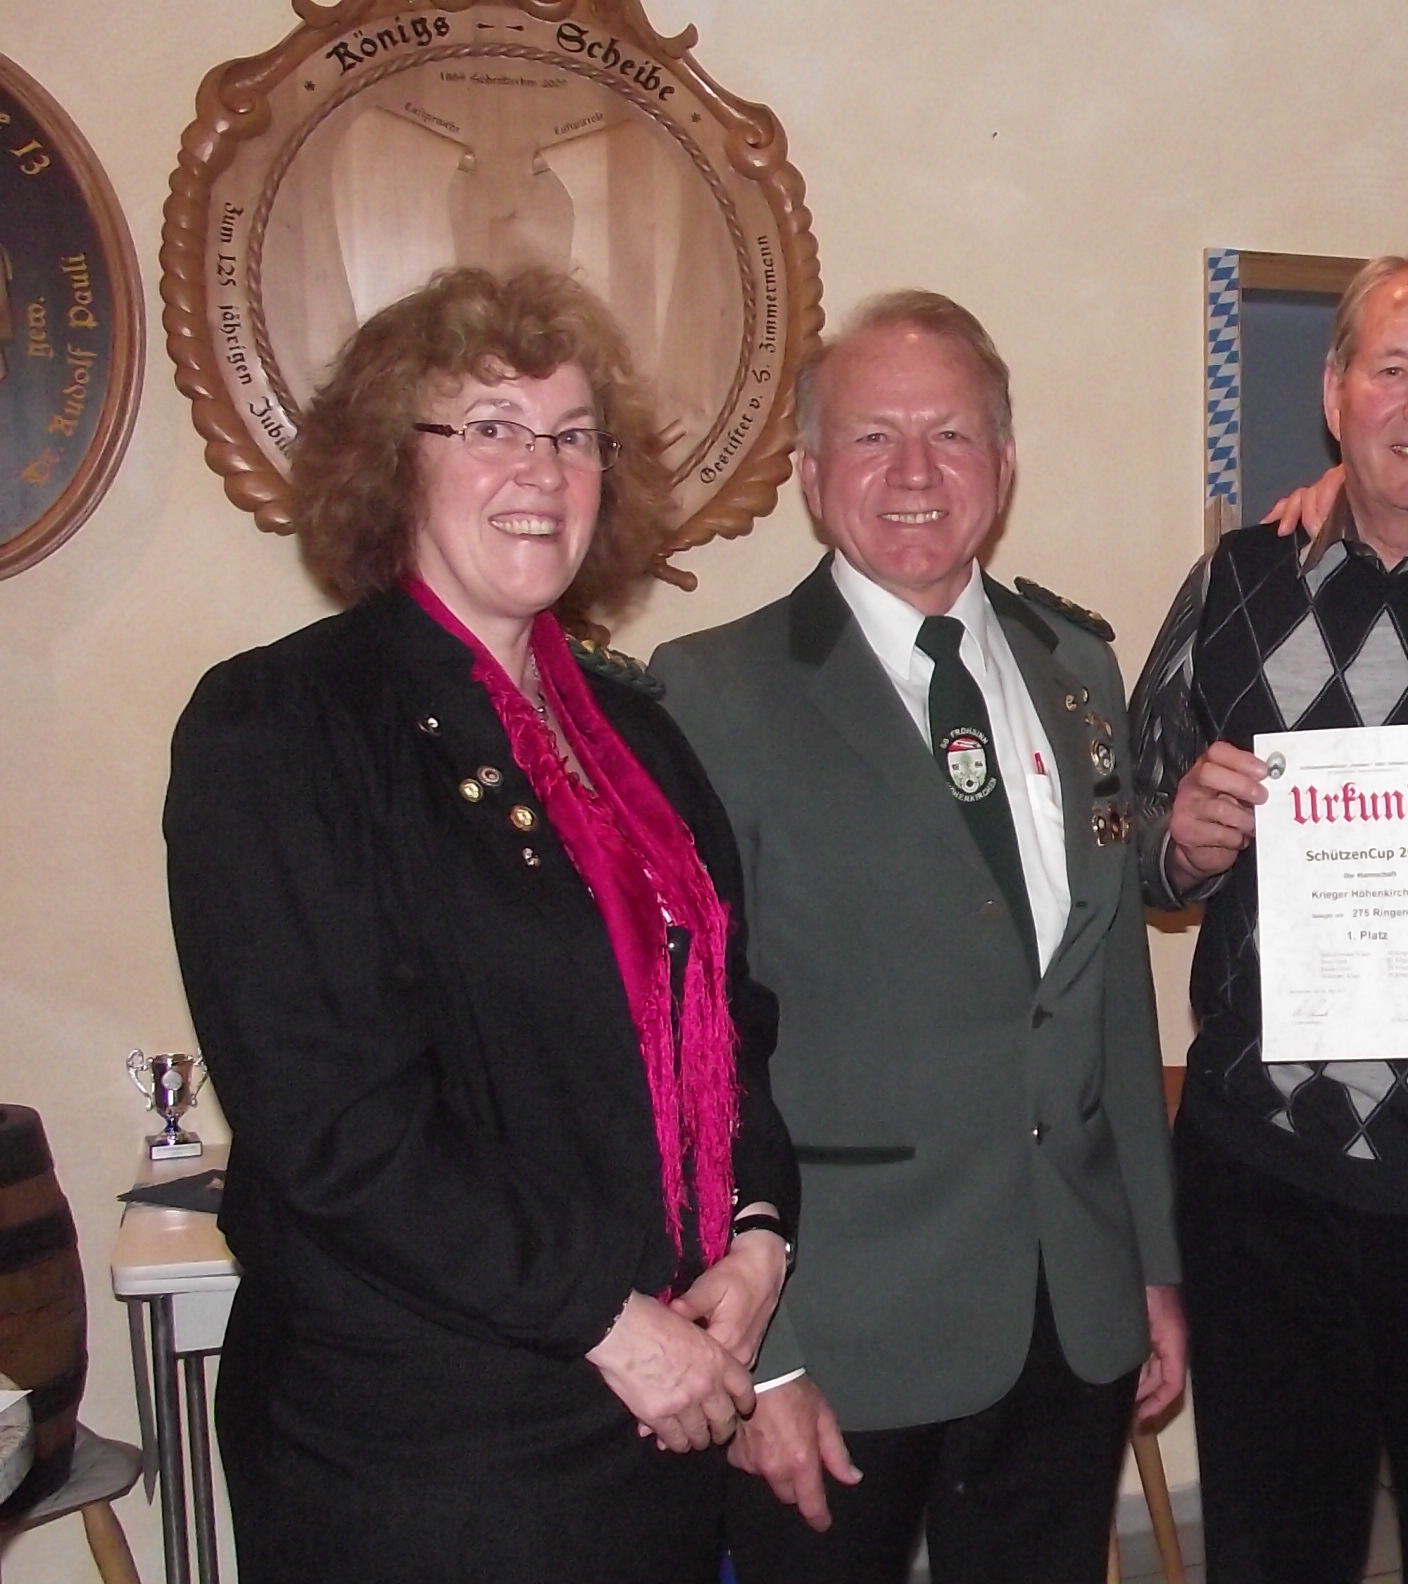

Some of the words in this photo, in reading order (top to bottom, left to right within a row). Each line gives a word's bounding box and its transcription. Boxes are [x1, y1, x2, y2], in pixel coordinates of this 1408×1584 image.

[325, 15, 451, 77] Königs
[555, 22, 676, 101] Scheibe
[216, 252, 238, 288] 125
[1305, 847, 1395, 862] SchützenCup
[1311, 890, 1348, 901] Krieger
[1352, 908, 1370, 918] 275
[1373, 908, 1408, 919] Ringen
[1360, 930, 1388, 941] Platz
